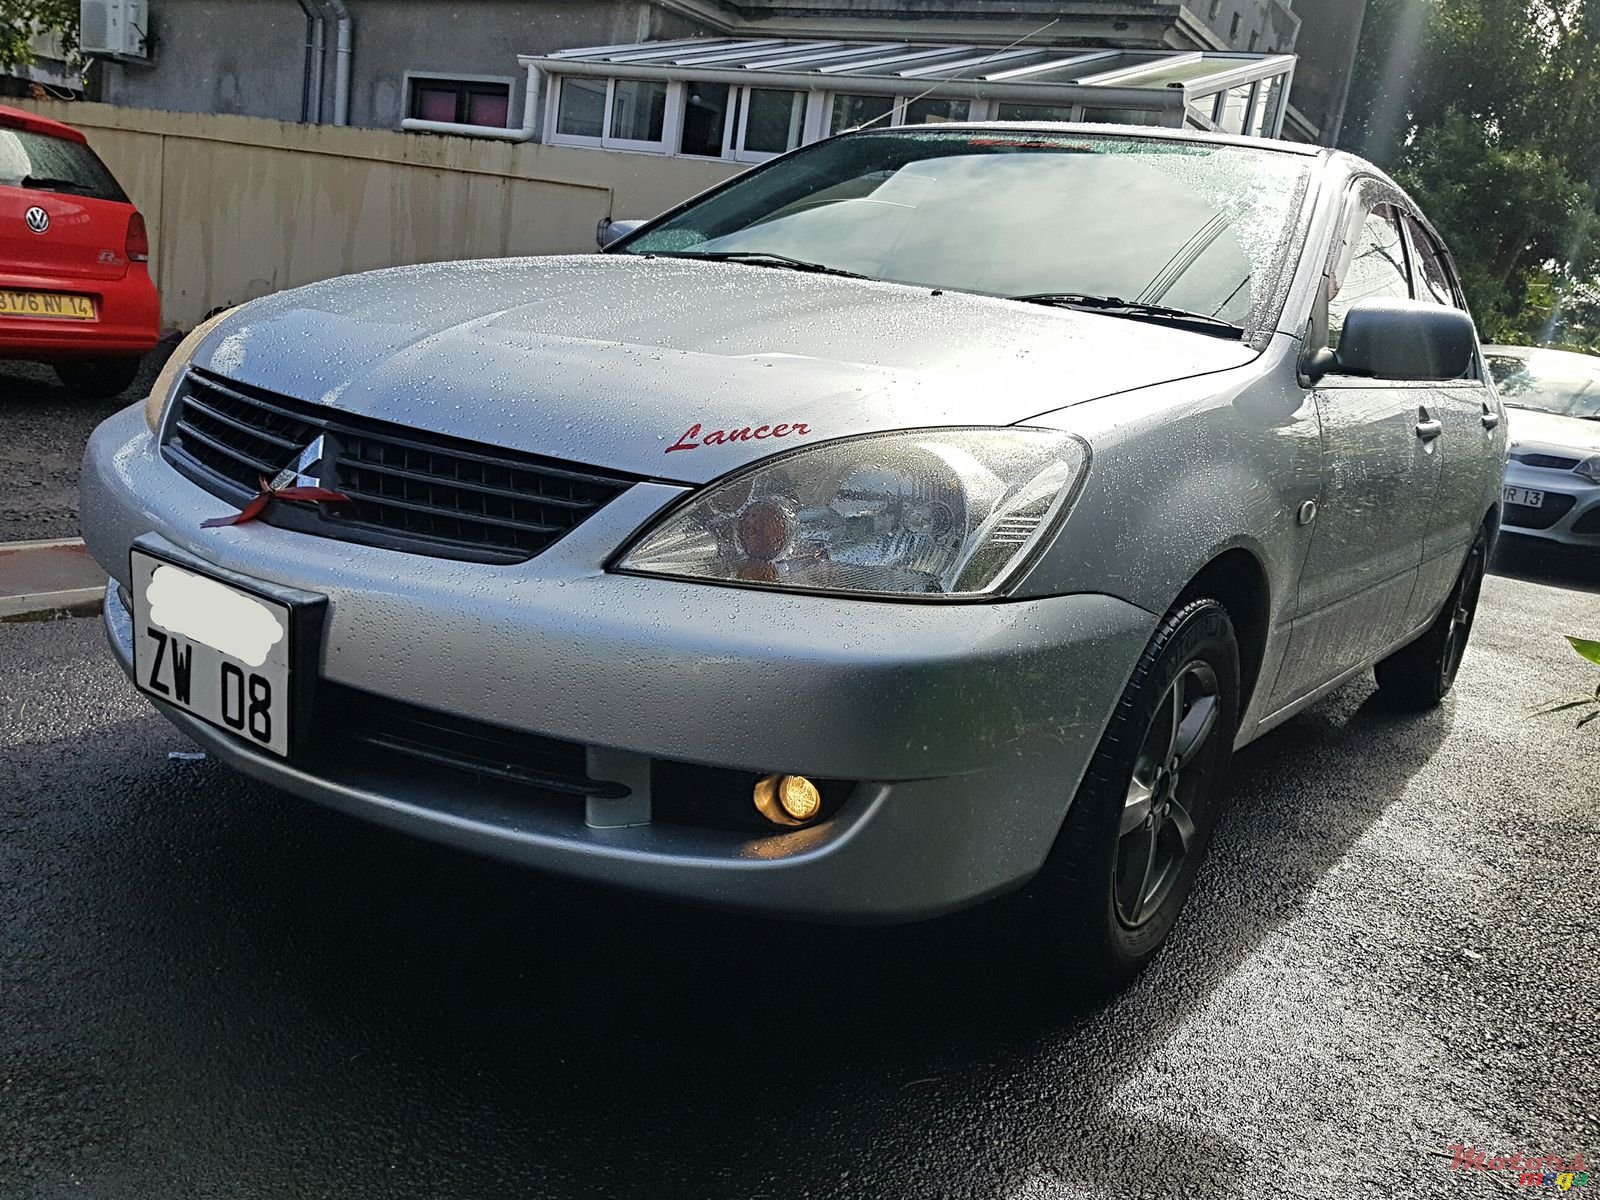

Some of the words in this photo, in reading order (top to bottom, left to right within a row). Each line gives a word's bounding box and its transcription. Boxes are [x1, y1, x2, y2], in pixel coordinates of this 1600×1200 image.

[69, 297, 88, 315] 14
[665, 423, 811, 453] Lancer
[1524, 491, 1541, 505] 13
[148, 627, 192, 705] ZW
[221, 661, 271, 744] 08
